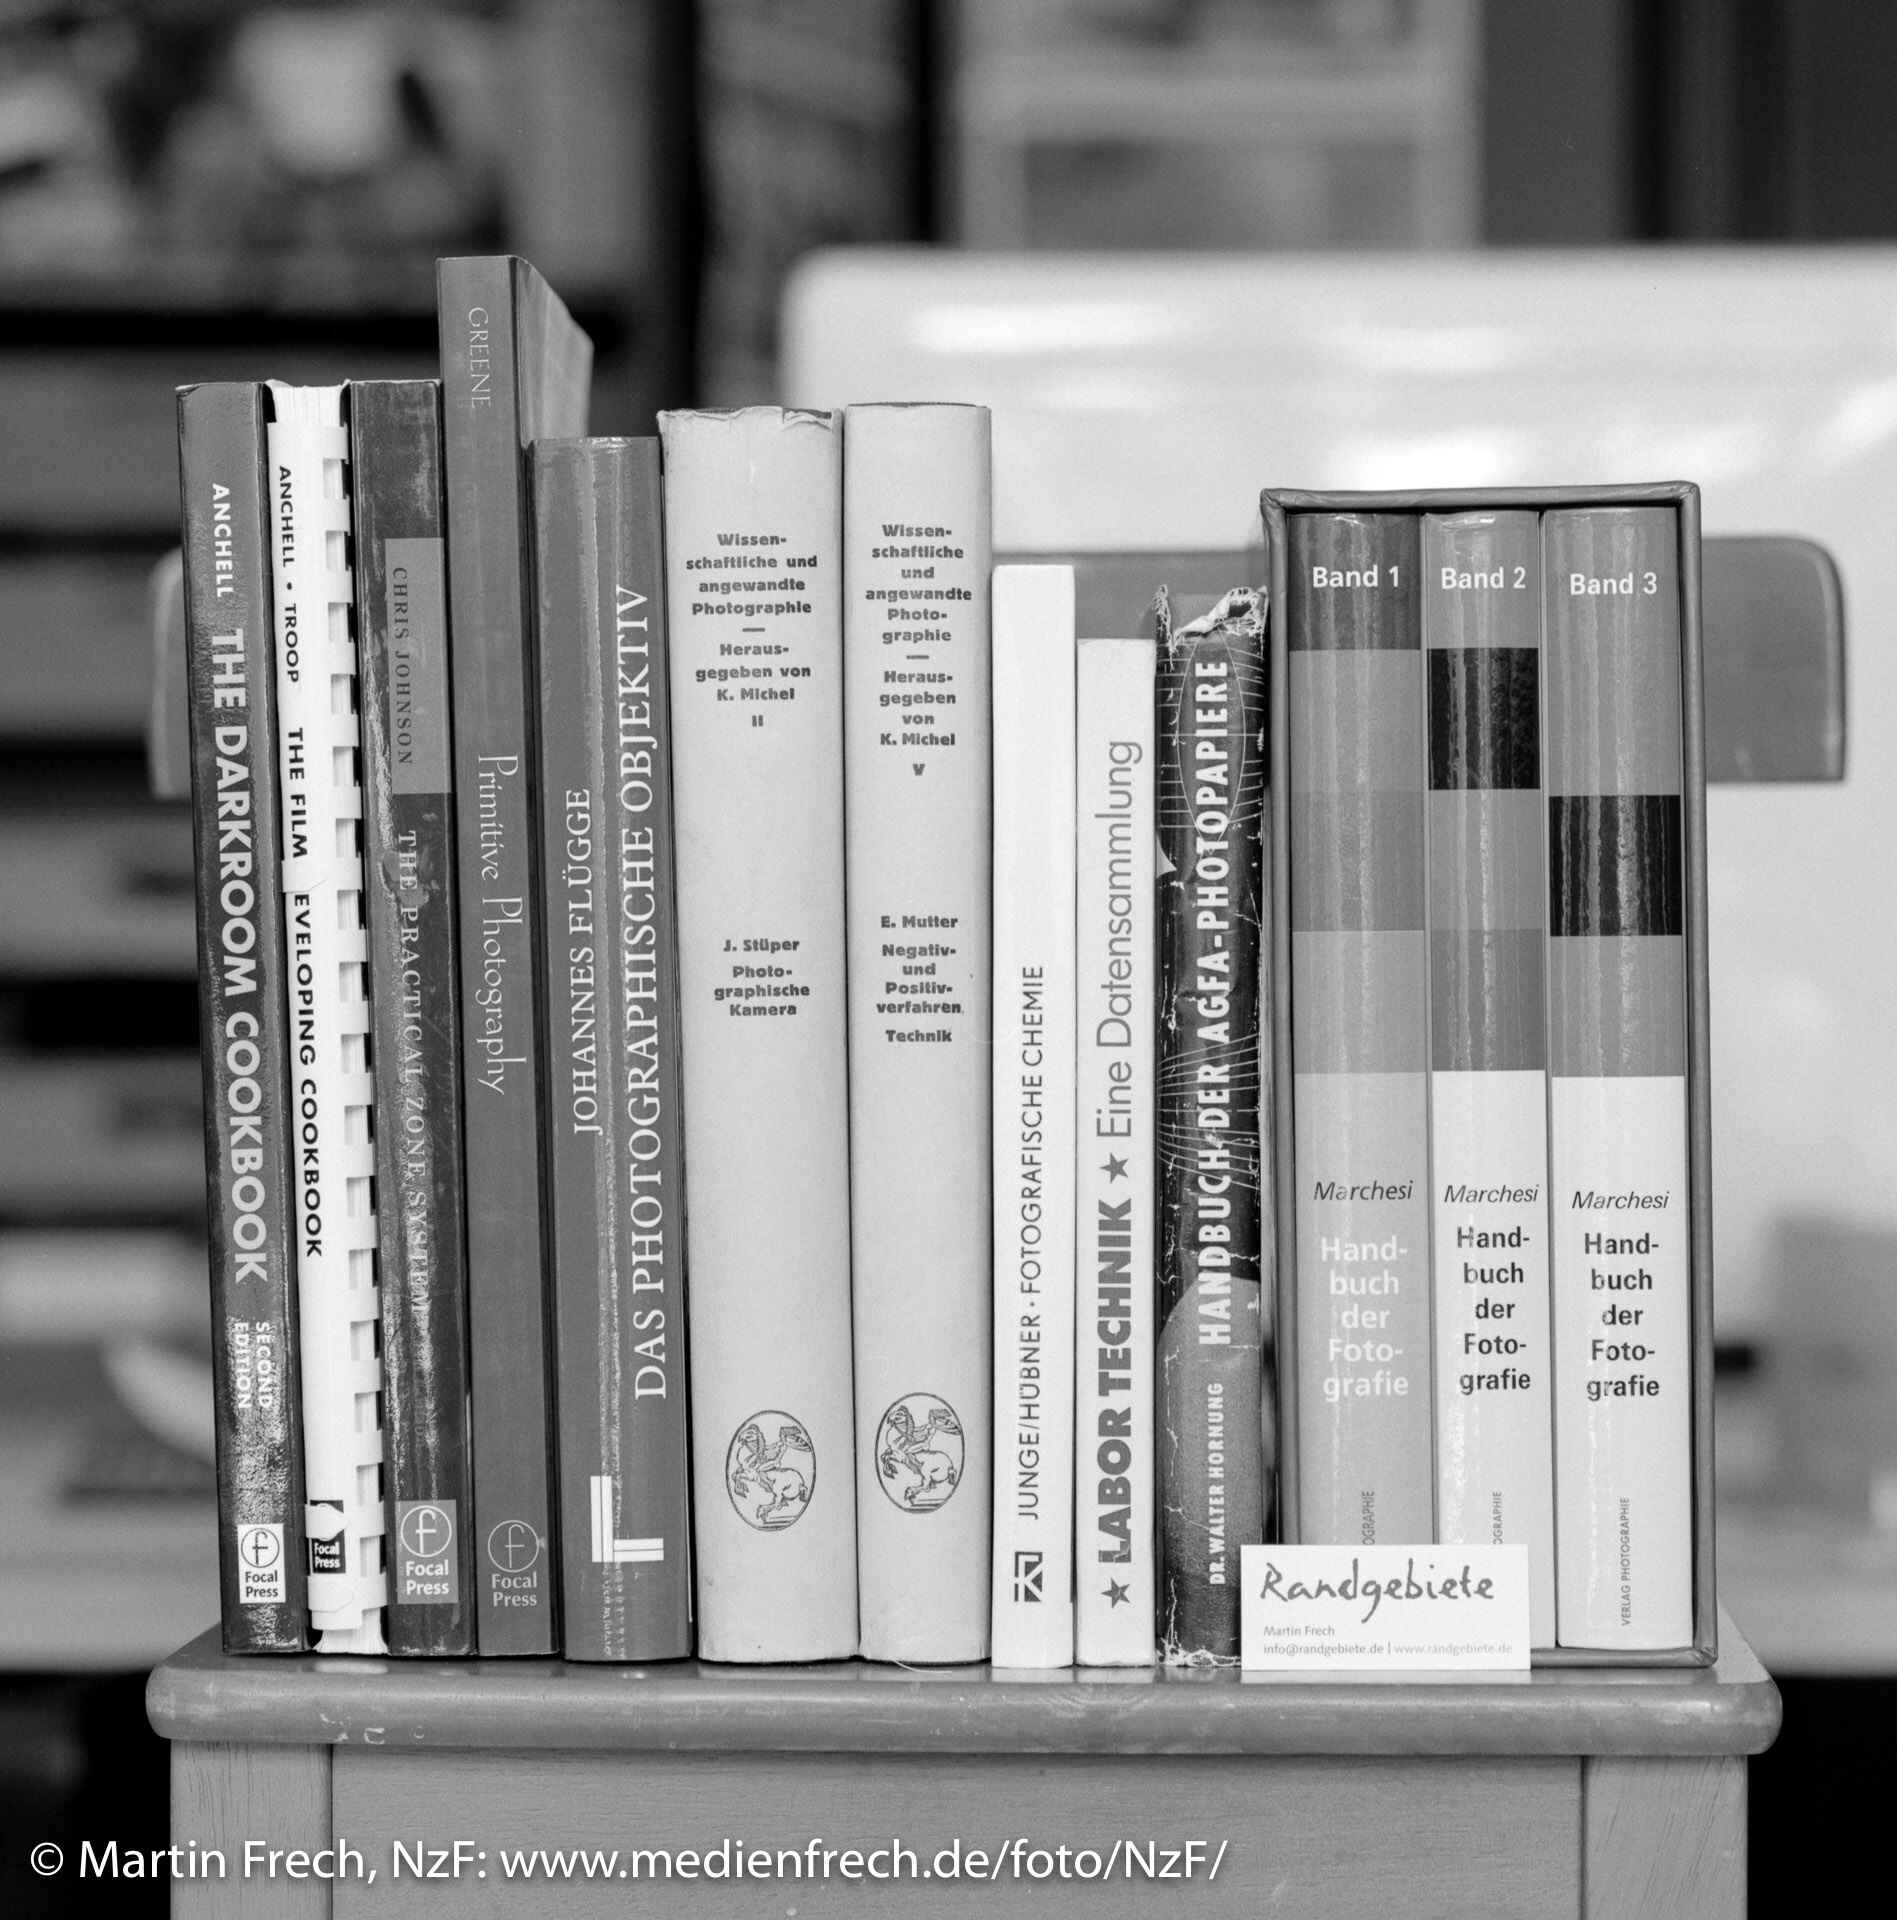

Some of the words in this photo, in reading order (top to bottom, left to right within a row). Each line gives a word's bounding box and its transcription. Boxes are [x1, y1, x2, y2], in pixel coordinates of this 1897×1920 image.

[468, 307, 491, 409] GREENE
[279, 465, 295, 567] ANCHELL
[212, 483, 234, 598] ANCHELL
[717, 533, 787, 546] Wissen-
[882, 524, 952, 537] Wissen-
[686, 556, 777, 570] schaftliche
[786, 555, 818, 568] und
[871, 546, 964, 559] schaftliche
[901, 567, 935, 579] und
[1312, 565, 1379, 588] Band
[1389, 566, 1400, 587] 1
[1441, 567, 1504, 589] Band
[1513, 567, 1527, 589] 2
[1569, 572, 1634, 595] Band
[1643, 572, 1658, 594] 3
[699, 579, 806, 595] angewandte
[865, 588, 972, 602] angewandte
[393, 567, 410, 640] CHRIS
[692, 601, 812, 616] Photographie
[887, 608, 948, 621] Photo-
[284, 603, 300, 684] TROOP
[882, 629, 952, 645] graphie
[719, 643, 789, 656] Heraus-
[212, 628, 245, 709] THE
[695, 666, 772, 682] gegeben
[780, 667, 811, 678] von
[884, 670, 953, 683] Heraus-
[615, 584, 658, 812] OBJEKTIV
[717, 689, 734, 701] K.
[740, 688, 795, 701] Michel
[879, 691, 956, 707] gegeben
[395, 650, 413, 764] JOHNSON
[902, 714, 935, 725] von
[880, 733, 897, 746] K.
[902, 733, 956, 746] Michel
[288, 727, 305, 781] THE
[912, 763, 926, 776] V
[290, 793, 308, 858] FILM
[478, 754, 519, 880] Primitive
[214, 725, 257, 998] DARKROOM
[398, 830, 419, 891] THE
[561, 788, 593, 935] FLÜGGE
[1195, 662, 1230, 1044] AGFA-PHOTOPAPIERE
[1094, 741, 1143, 1048] Datensammlung
[881, 916, 896, 929] E.
[902, 915, 958, 929] Mutter
[723, 940, 737, 952] J.
[743, 938, 800, 955] Stüper
[882, 944, 956, 959] Negativ-
[294, 893, 316, 1066] EVELOPING
[732, 965, 792, 978] Photo-
[902, 963, 936, 976] und
[400, 906, 423, 1084] PRACTICAL
[475, 897, 526, 1095] Photography
[714, 984, 810, 1000] graphische
[885, 981, 953, 995] Positiv-
[730, 1004, 797, 1016] Kamera
[1022, 966, 1043, 1067] CHEMIE
[569, 947, 603, 1135] JOHANNES
[885, 1030, 952, 1042] Technik
[622, 826, 665, 1294] PHOTOGRAPHISCHE
[1096, 1061, 1132, 1137] Eine
[1198, 1063, 1230, 1128] DER
[225, 1011, 268, 1284] COOKBOOK
[404, 1096, 426, 1177] ZONE
[300, 1078, 323, 1257] COOKBOOK
[1020, 1075, 1043, 1294] FOTOGRAFISCHE
[1314, 1180, 1414, 1201] Marchesi
[1444, 1184, 1540, 1203] Marchesi
[1572, 1190, 1670, 1209] Marchesi
[1198, 1150, 1231, 1344] HANDBUCH
[1320, 1235, 1408, 1262] Hand-
[1457, 1226, 1530, 1249] Hand-
[1584, 1232, 1659, 1255] Hand-
[1329, 1268, 1400, 1295] buch
[1463, 1262, 1525, 1284] buch
[1591, 1268, 1653, 1291] buch
[1097, 1198, 1131, 1396] TECHNIK
[1475, 1298, 1515, 1319] der
[1341, 1304, 1391, 1329] der
[1602, 1304, 1643, 1326] der
[632, 1308, 667, 1400] DAS
[1328, 1338, 1403, 1363] Foto-
[1464, 1333, 1527, 1355] Foto-
[1591, 1339, 1655, 1361] Foto-
[234, 1321, 252, 1410] EDITION
[255, 1321, 273, 1409] SECOND
[1323, 1371, 1409, 1401] grafie
[1459, 1368, 1531, 1395] grafie
[1586, 1375, 1660, 1401] grafie
[1018, 1313, 1041, 1520] JUNGE/HÜBNER
[1207, 1382, 1225, 1479] HORNUNG
[1097, 1406, 1131, 1563] LABOR
[1208, 1484, 1225, 1554] WALTER
[1362, 1490, 1375, 1545] OGRAPHIE
[314, 1541, 340, 1555] Focal
[1619, 1496, 1631, 1584] PHOTOGRAPHIE
[314, 1557, 340, 1569] Press
[406, 1560, 449, 1576] Focal
[1209, 1556, 1226, 1585] DR.
[245, 1570, 278, 1583] Focal
[406, 1579, 449, 1595] Press
[492, 1572, 537, 1589] Focal
[245, 1586, 278, 1598] Press
[492, 1591, 537, 1607] Press
[1260, 1558, 1494, 1624] Randgebiete
[1621, 1586, 1632, 1627] VERLAG
[1263, 1625, 1302, 1636] Martin
[1305, 1625, 1335, 1636] Frech
[1263, 1643, 1384, 1657] info@randgebiete.de
[1393, 1643, 1513, 1657] www.randgebiete.de
